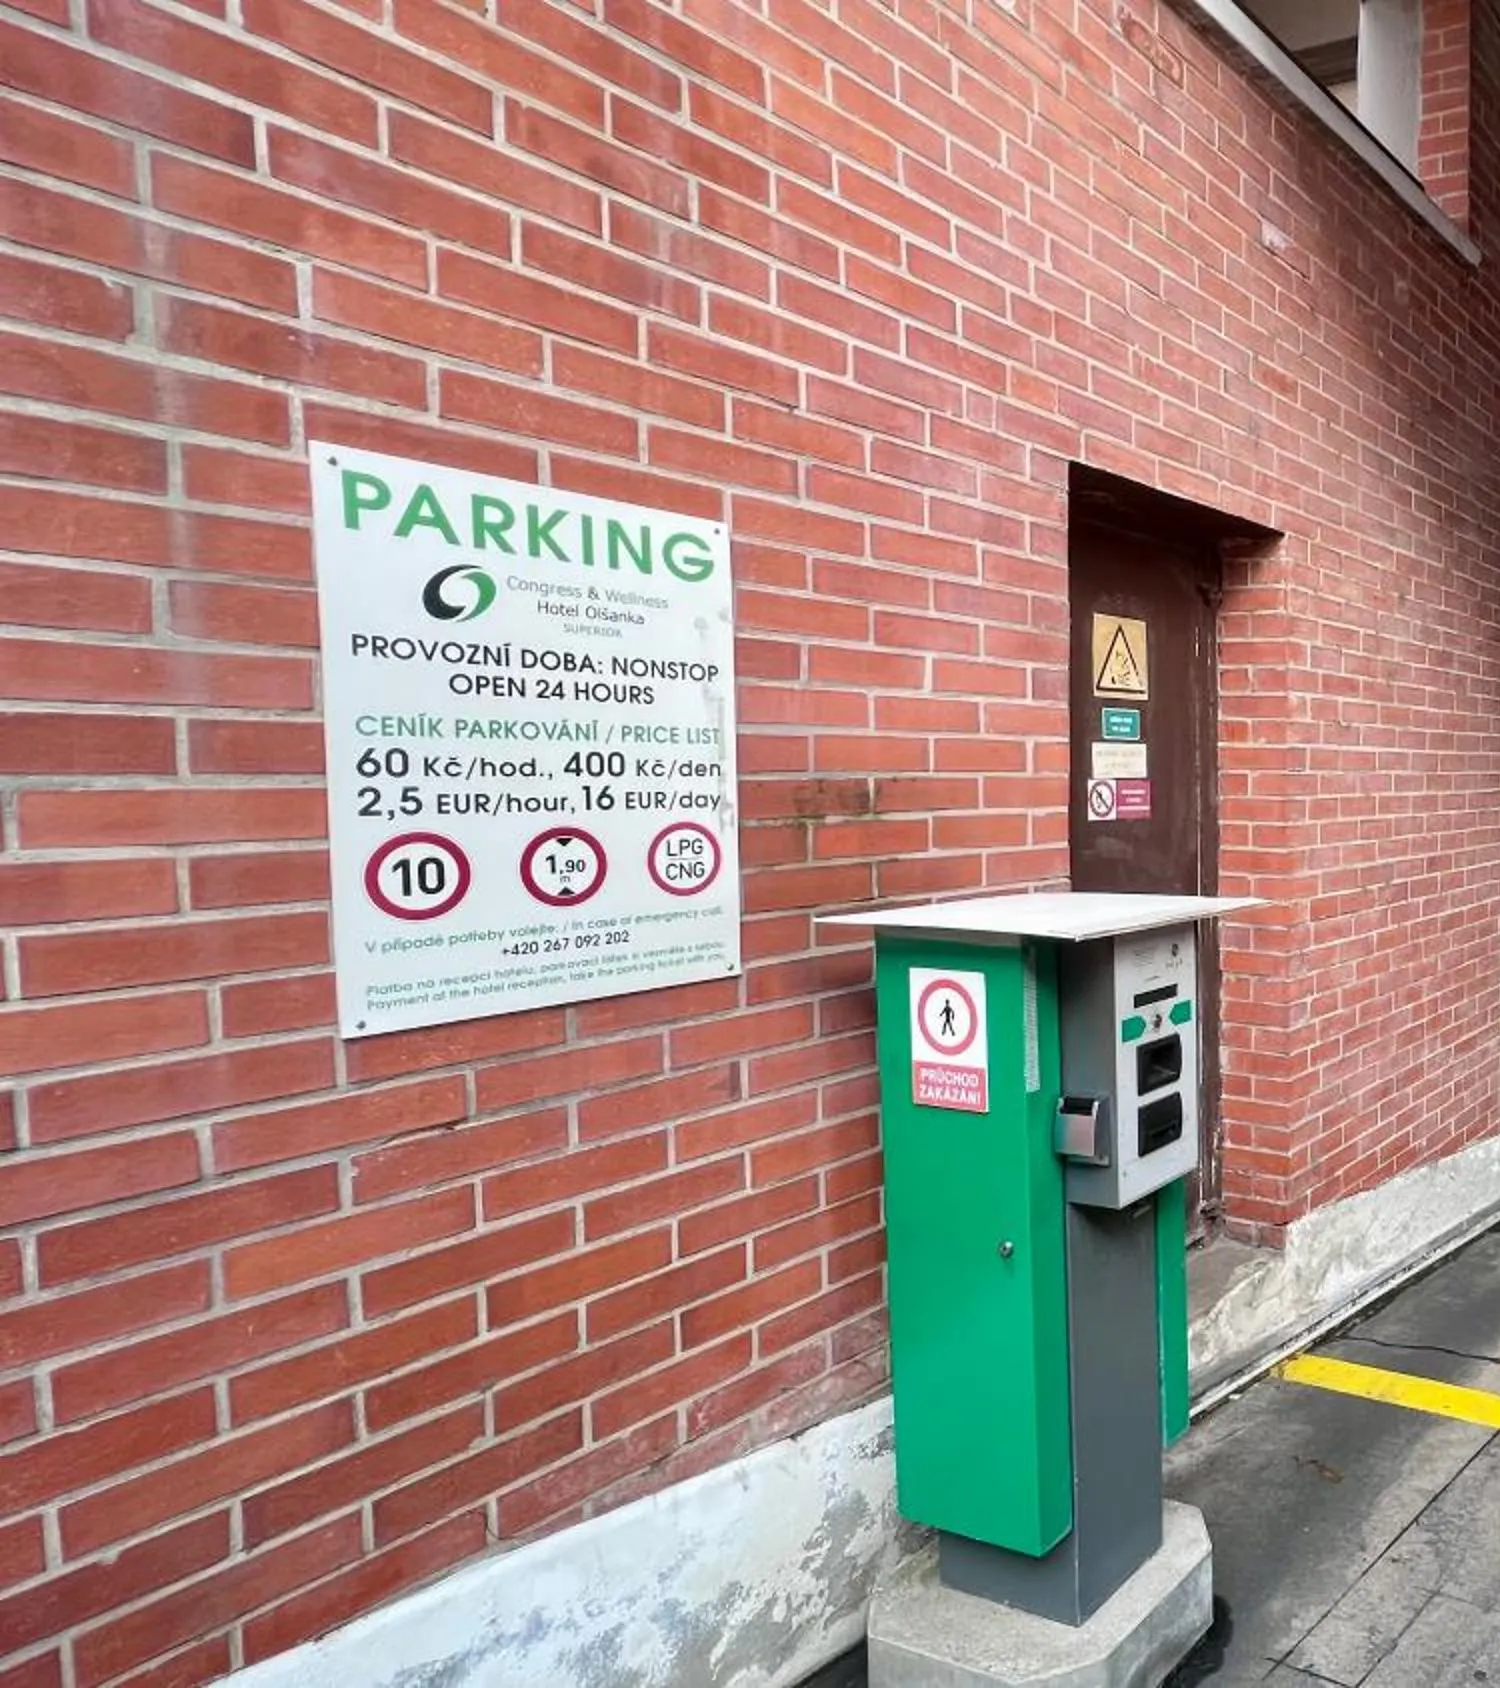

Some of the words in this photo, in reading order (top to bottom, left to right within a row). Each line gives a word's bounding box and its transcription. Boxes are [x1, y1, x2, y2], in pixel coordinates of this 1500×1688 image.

[340, 469, 715, 583] PARKING
[506, 575, 582, 598] Congress
[588, 586, 600, 600] &
[605, 589, 669, 609] Wellness
[537, 600, 579, 617] Hotel
[585, 604, 645, 625] Olšanka
[563, 624, 623, 638] SUPERIOR
[351, 634, 512, 667] PROVOZNÍ
[521, 649, 603, 674] DOBA:
[611, 656, 719, 683] NONSTOP
[448, 673, 527, 698] OPEN
[535, 679, 565, 700] 24
[574, 681, 655, 705] HOURS
[355, 713, 445, 738] CENÍK
[455, 719, 599, 741] PARKOVÁNÍ
[605, 723, 615, 744] /
[621, 725, 680, 744] PRICE
[687, 727, 720, 745] LIST
[355, 747, 409, 778] 60
[423, 757, 553, 781] Kč/hod.,
[563, 751, 626, 777] 400
[636, 759, 721, 780] Kč/den
[357, 785, 423, 821] 2,5
[436, 793, 576, 816] EUR/hour,
[582, 785, 615, 811] 16
[625, 790, 721, 811] EUR/day
[666, 838, 704, 857] LPG
[391, 857, 446, 897] 10
[545, 854, 587, 874] 1,90
[665, 861, 705, 880] CNG
[364, 941, 376, 953] V
[502, 942, 539, 956] +420
[543, 937, 570, 951] 267
[575, 934, 601, 949] 092
[605, 929, 630, 944] 202
